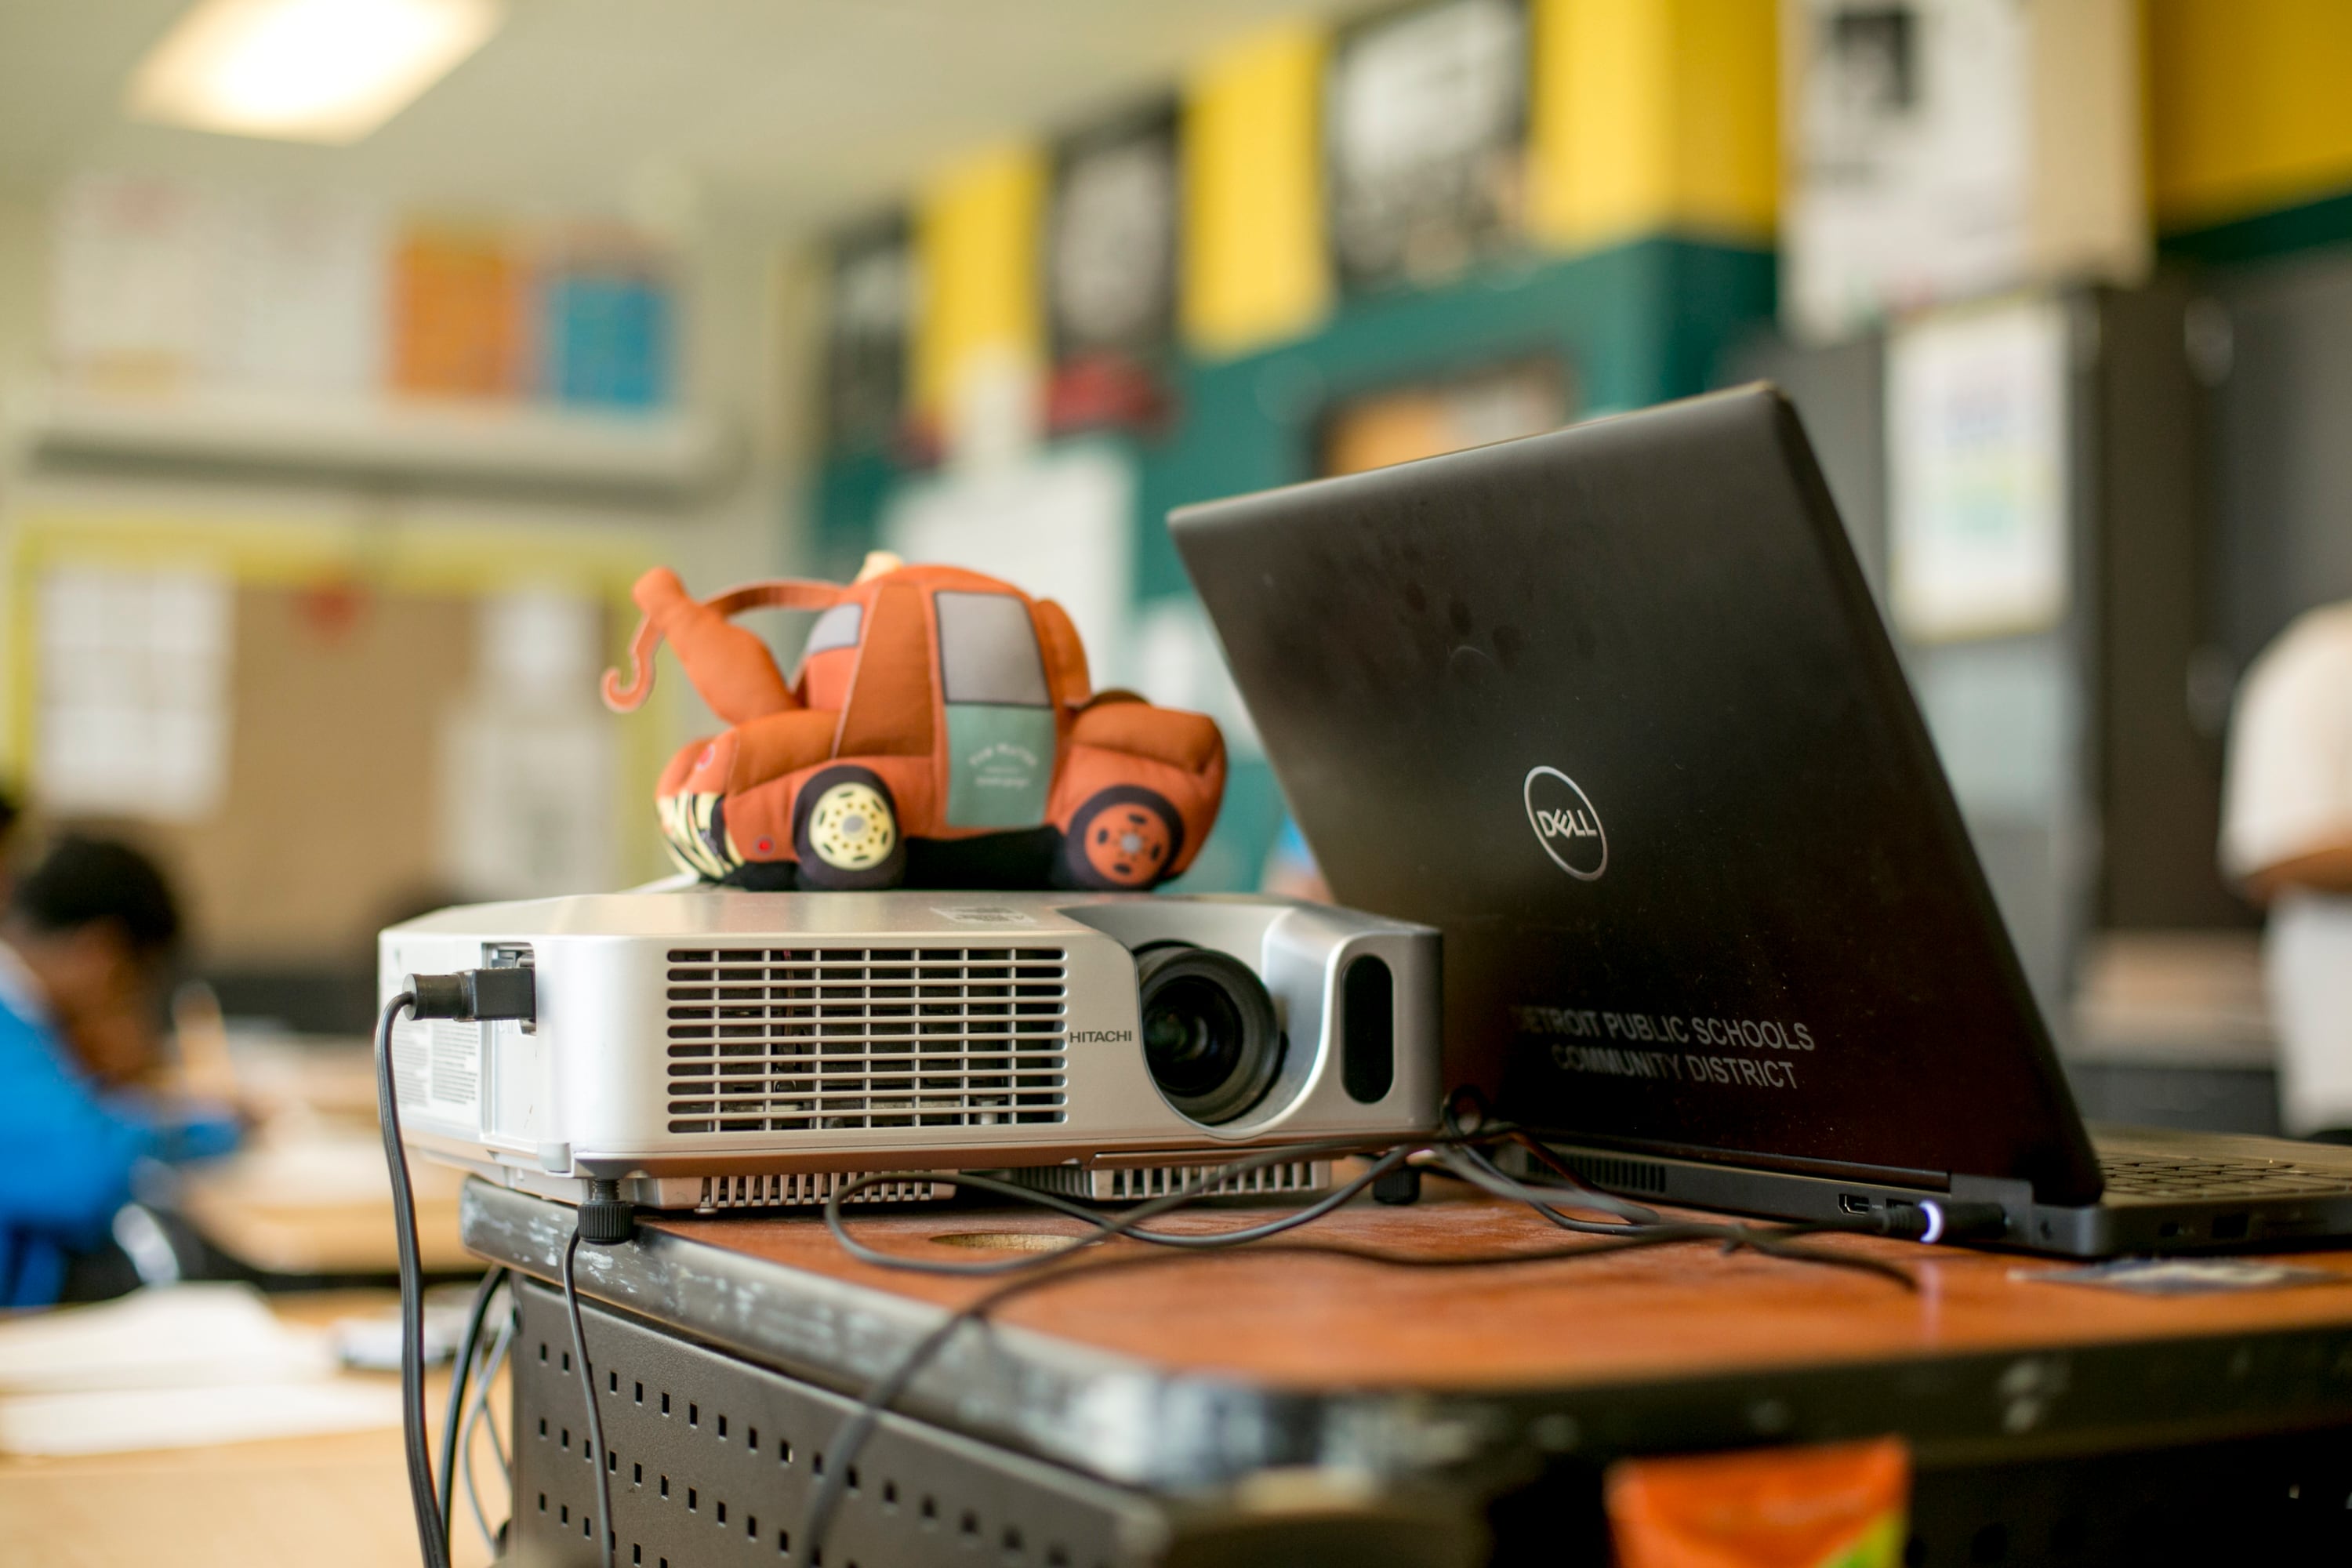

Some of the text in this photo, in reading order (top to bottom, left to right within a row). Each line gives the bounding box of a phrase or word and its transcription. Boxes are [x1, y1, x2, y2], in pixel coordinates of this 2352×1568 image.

[1537, 808, 1598, 838] DELL
[1069, 1030, 1132, 1044] HITACHI
[1602, 1011, 1690, 1044] PUBLIC
[1691, 1018, 1815, 1051] SCHOOLS
[1552, 1044, 1798, 1089] COMMUNITY DISTRICT
